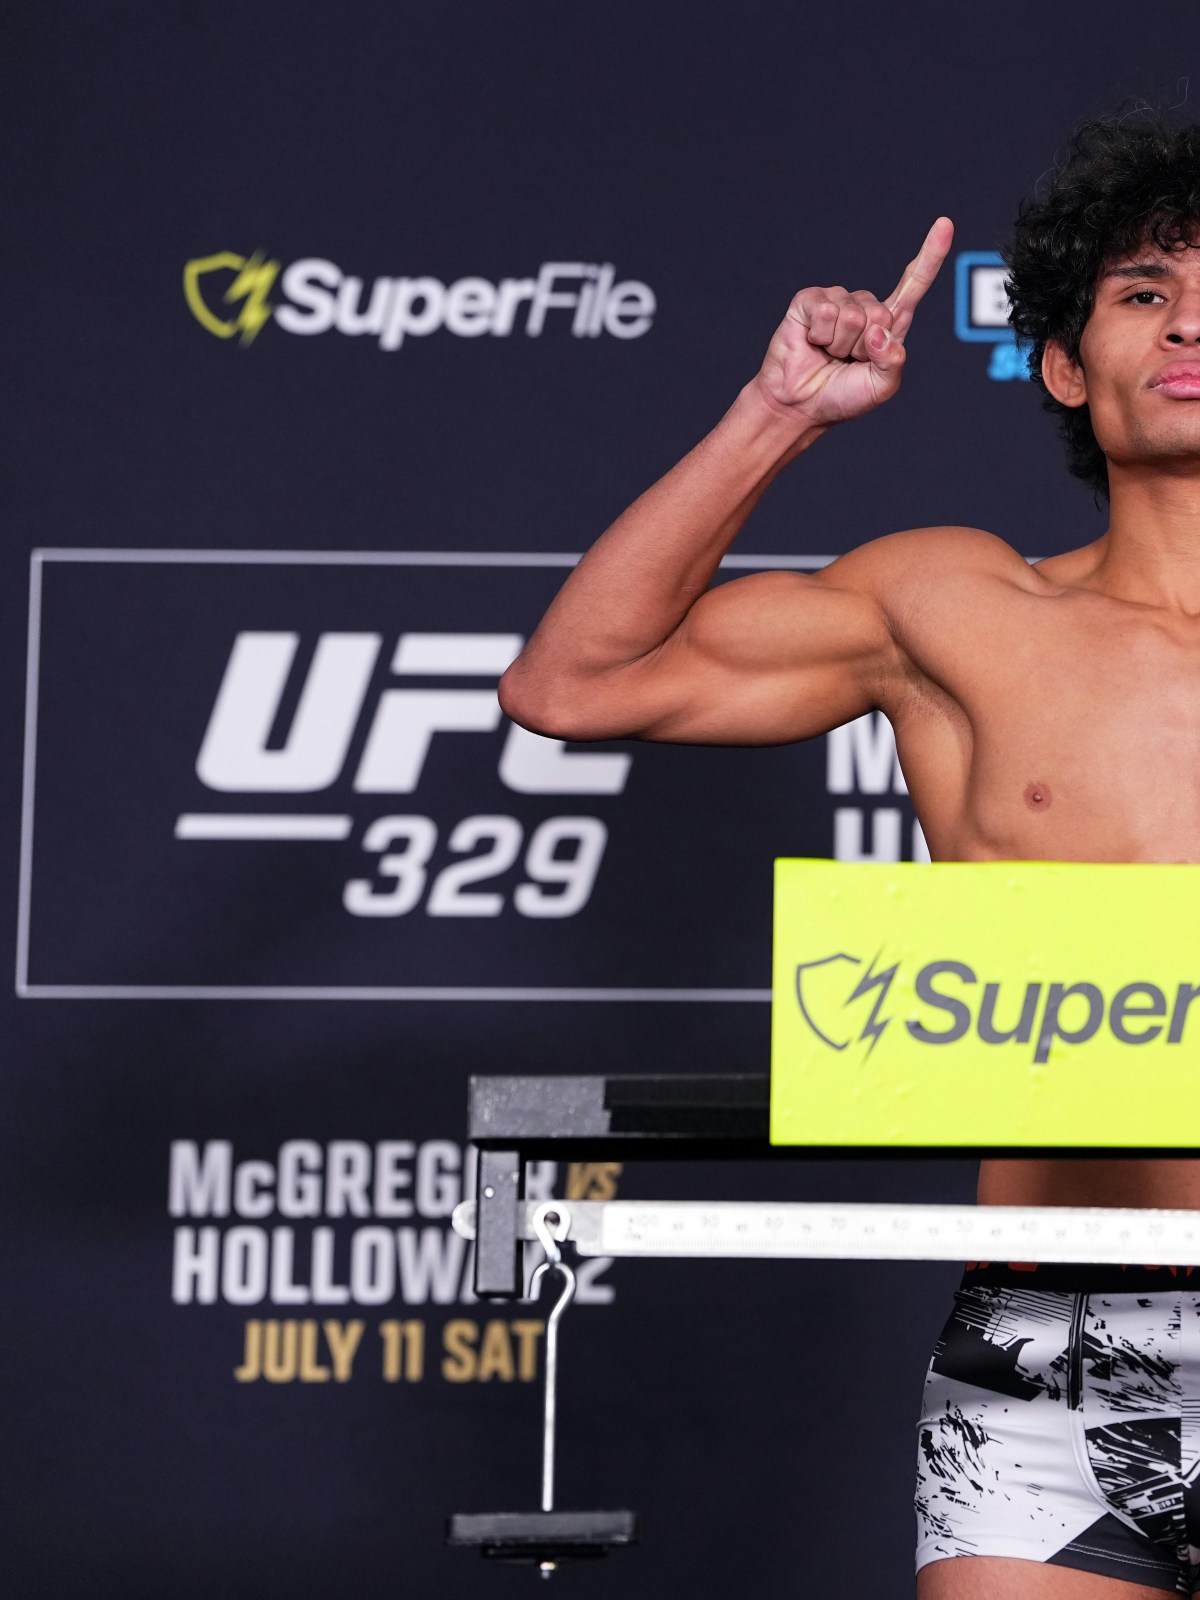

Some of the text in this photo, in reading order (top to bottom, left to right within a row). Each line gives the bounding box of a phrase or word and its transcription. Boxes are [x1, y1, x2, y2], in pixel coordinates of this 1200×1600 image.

[273, 258, 656, 351] SuperFile
[343, 815, 607, 917] 329
[169, 1140, 557, 1219] McGREG
[172, 1226, 546, 1304] HOLLOW
[235, 1320, 545, 1382] JULY 11 SAT
